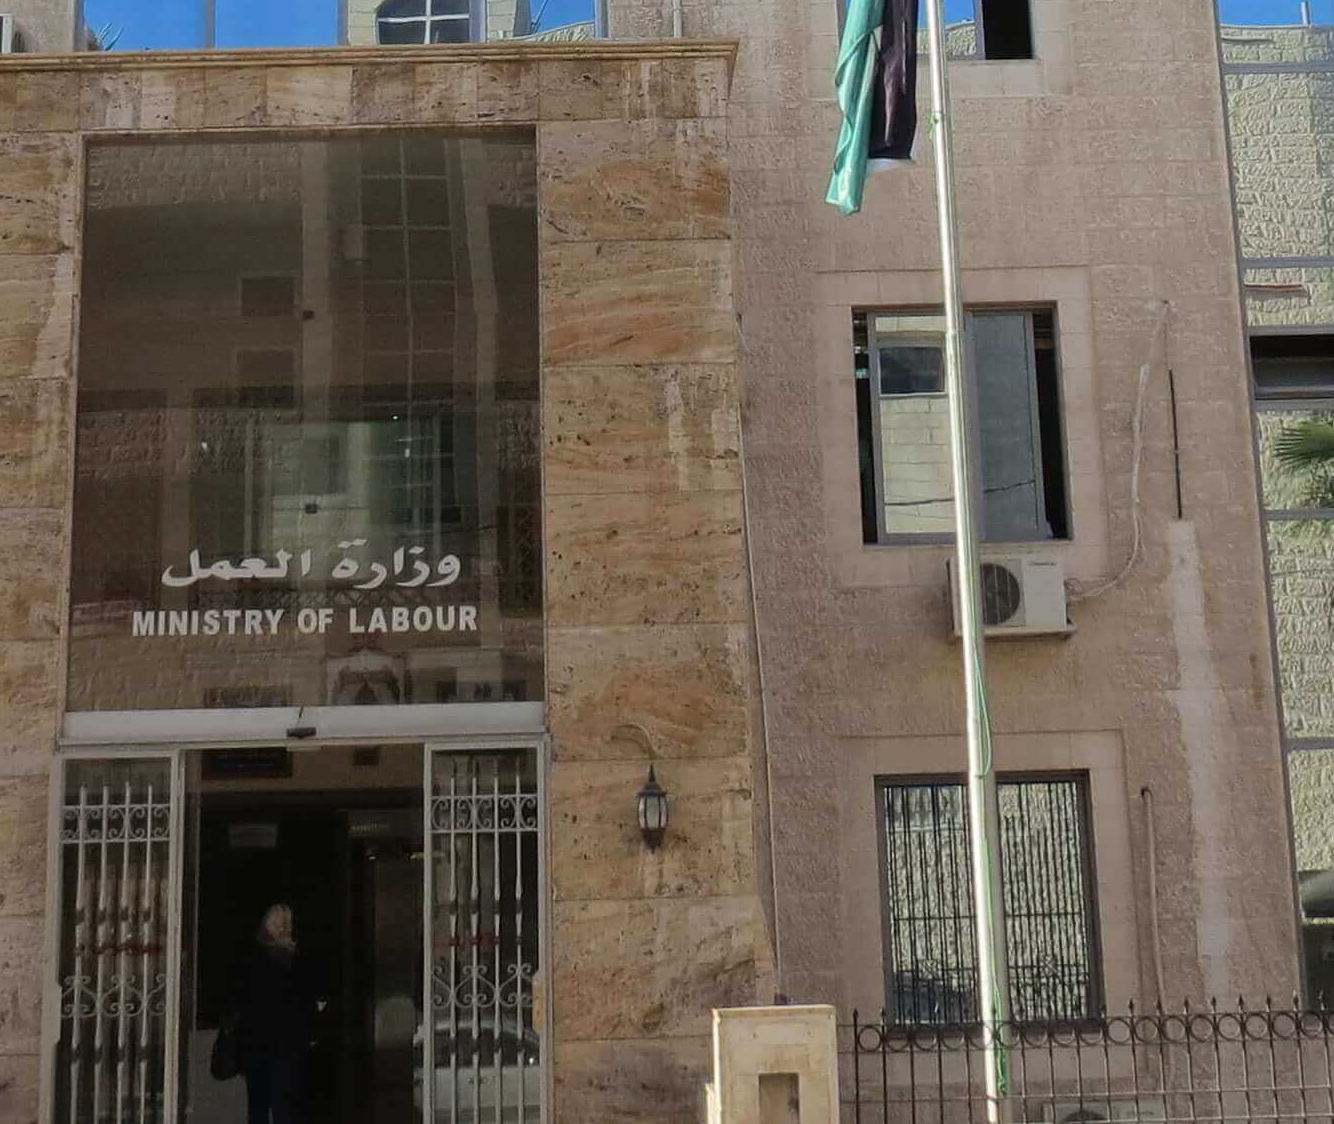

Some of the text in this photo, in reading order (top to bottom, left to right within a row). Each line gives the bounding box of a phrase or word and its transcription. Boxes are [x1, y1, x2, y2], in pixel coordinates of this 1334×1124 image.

[161, 538, 461, 589] وزارة العمل
[132, 604, 478, 637] MINISTRY OF LABOUR
